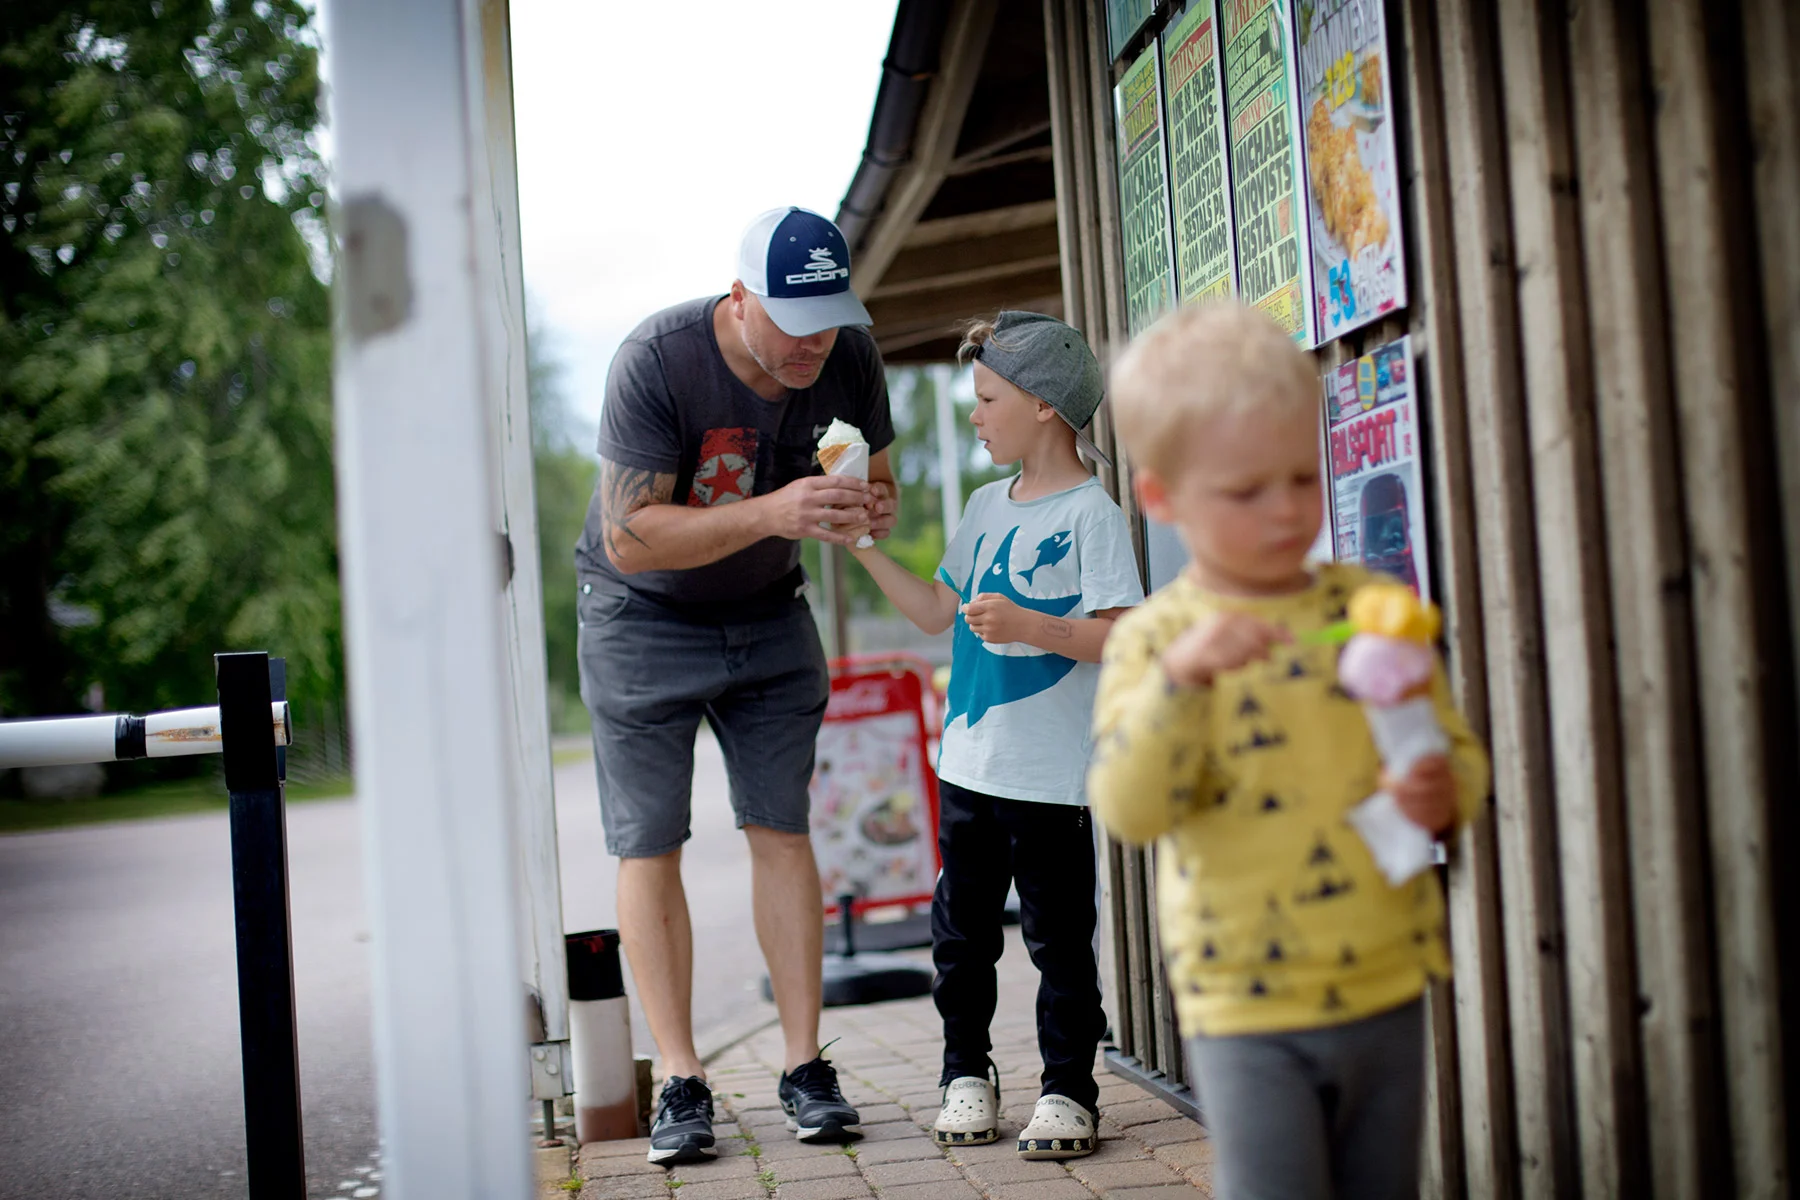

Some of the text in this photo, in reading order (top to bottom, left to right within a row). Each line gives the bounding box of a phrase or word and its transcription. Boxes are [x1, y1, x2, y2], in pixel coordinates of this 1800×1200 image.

[1192, 58, 1215, 104] FÖLJDES
[1271, 76, 1284, 108] TV
[1324, 50, 1355, 112] 120
[1175, 90, 1217, 157] AV WILLYS-
[1235, 108, 1288, 186] MICHAEL
[1176, 123, 1219, 189] BEDRAGARNA
[1181, 156, 1222, 216] HALMSTAD
[1184, 197, 1212, 246] BESTALS
[1213, 186, 1225, 223] PÅ
[1237, 149, 1292, 226] NYQVISTS
[1199, 220, 1227, 268] KRONOR
[1240, 208, 1272, 266] SISTA
[785, 267, 849, 285] cobra
[1243, 247, 1276, 306] SVÅRA
[1277, 234, 1298, 284] TID
[1329, 258, 1355, 327] 53
[1332, 409, 1397, 479] BILSPORT
